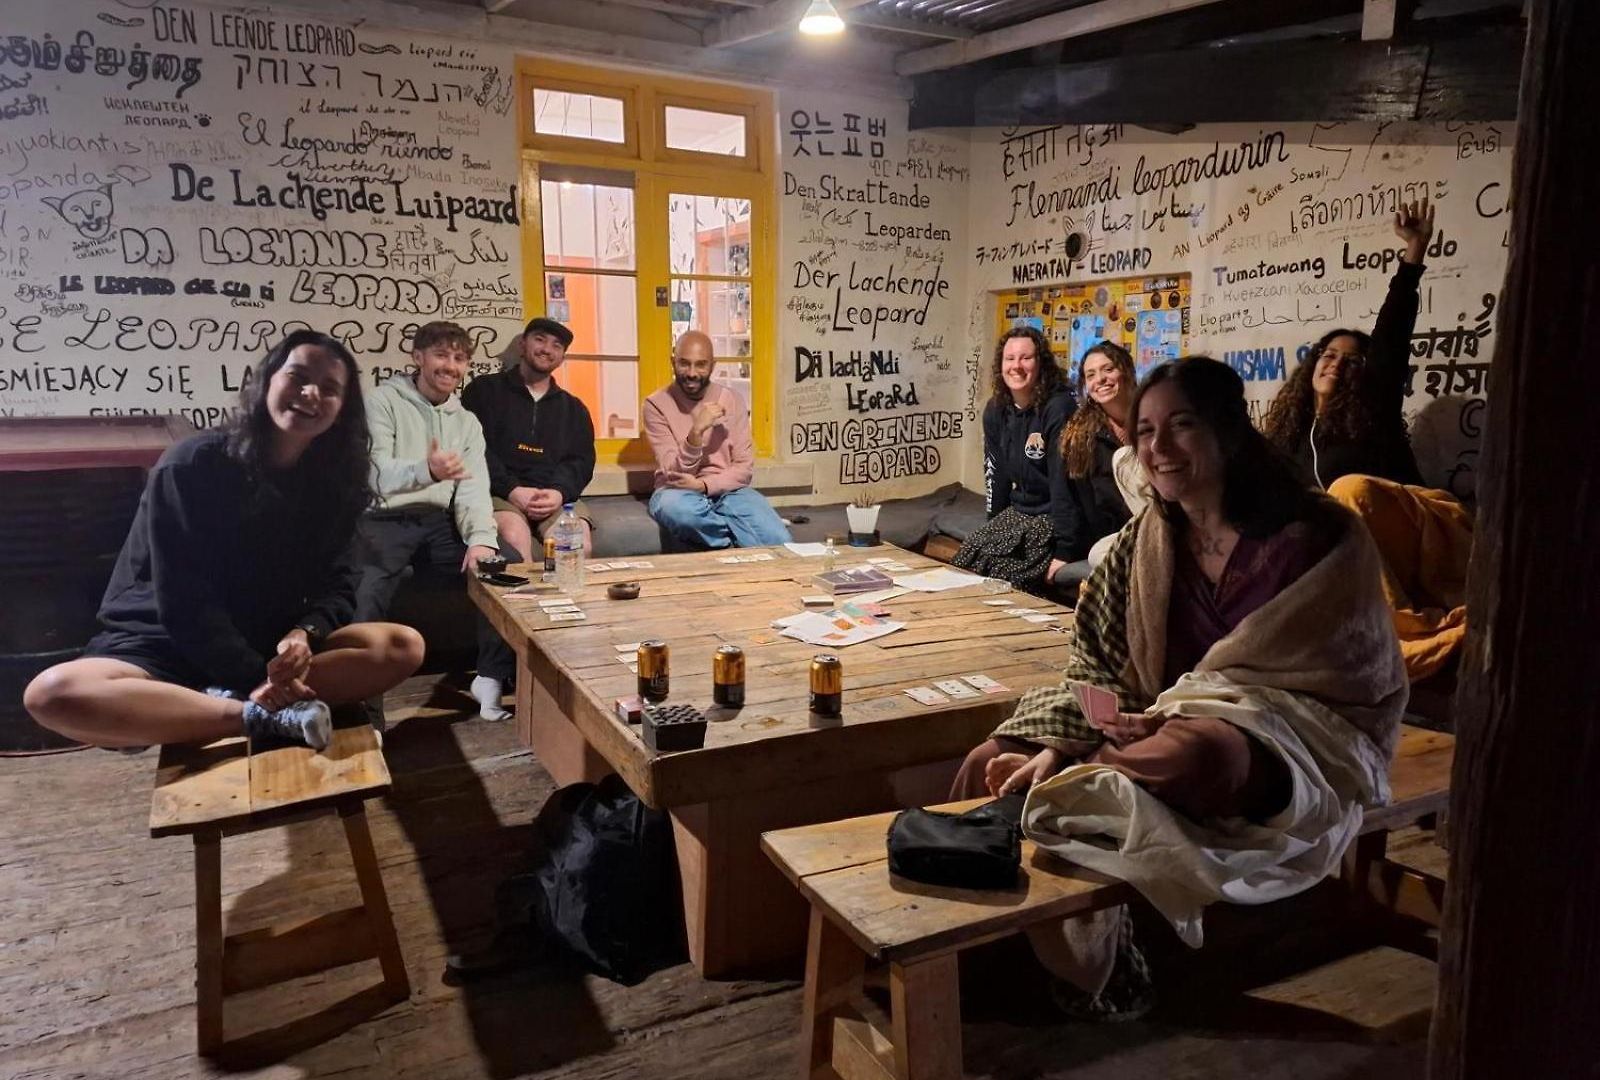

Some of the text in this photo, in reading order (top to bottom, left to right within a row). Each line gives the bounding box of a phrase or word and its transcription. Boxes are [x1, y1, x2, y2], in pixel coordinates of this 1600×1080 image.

[153, 7, 355, 57] DEN LEENDE LEOPARD
[238, 112, 271, 147] El
[790, 110, 834, 157] 웃는
[842, 113, 886, 158] 표범
[169, 163, 521, 232] De Lachende Luipaard
[784, 171, 931, 209] Den Skrattande
[120, 227, 175, 265] DA
[864, 211, 952, 246] Leoparden
[793, 261, 840, 289] Der
[1013, 259, 1073, 284] NAERATAV
[1090, 247, 1152, 275] LEOPARD
[1213, 256, 1326, 287] Tumatawang
[1342, 229, 1458, 274] Leopdo
[290, 269, 441, 315] LEOPARD
[0, 305, 46, 353] E
[329, 320, 502, 358] RIER
[833, 287, 931, 341] Leopard
[791, 411, 963, 454] DEN GRINENDE
[840, 446, 941, 485] LEOPARD
